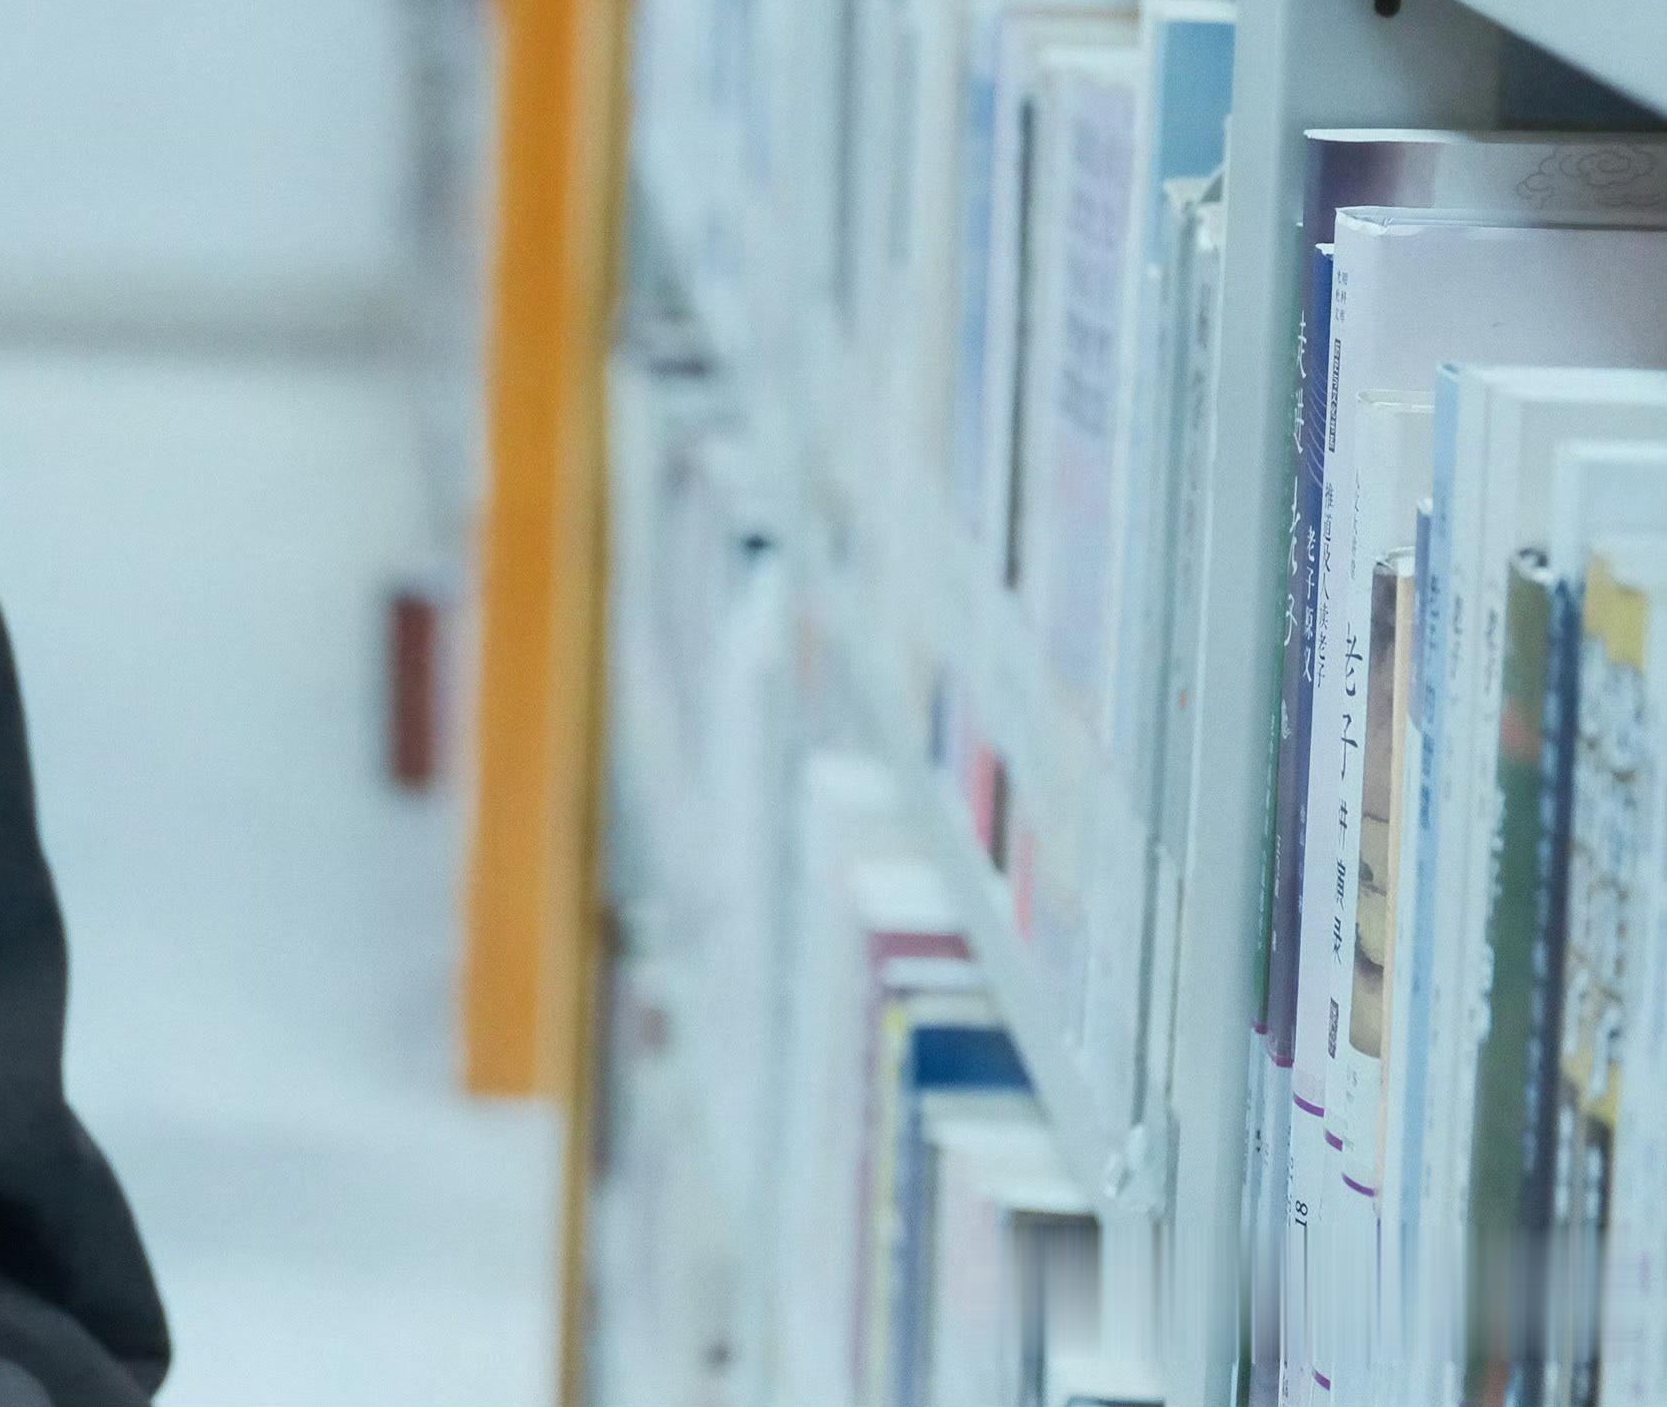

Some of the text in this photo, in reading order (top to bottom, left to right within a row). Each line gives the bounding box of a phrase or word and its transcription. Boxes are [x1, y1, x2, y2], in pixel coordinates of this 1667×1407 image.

[1284, 310, 1307, 646] 走进老子
[1302, 525, 1317, 683] 老子原义
[1316, 482, 1334, 689] 推道及人读老子
